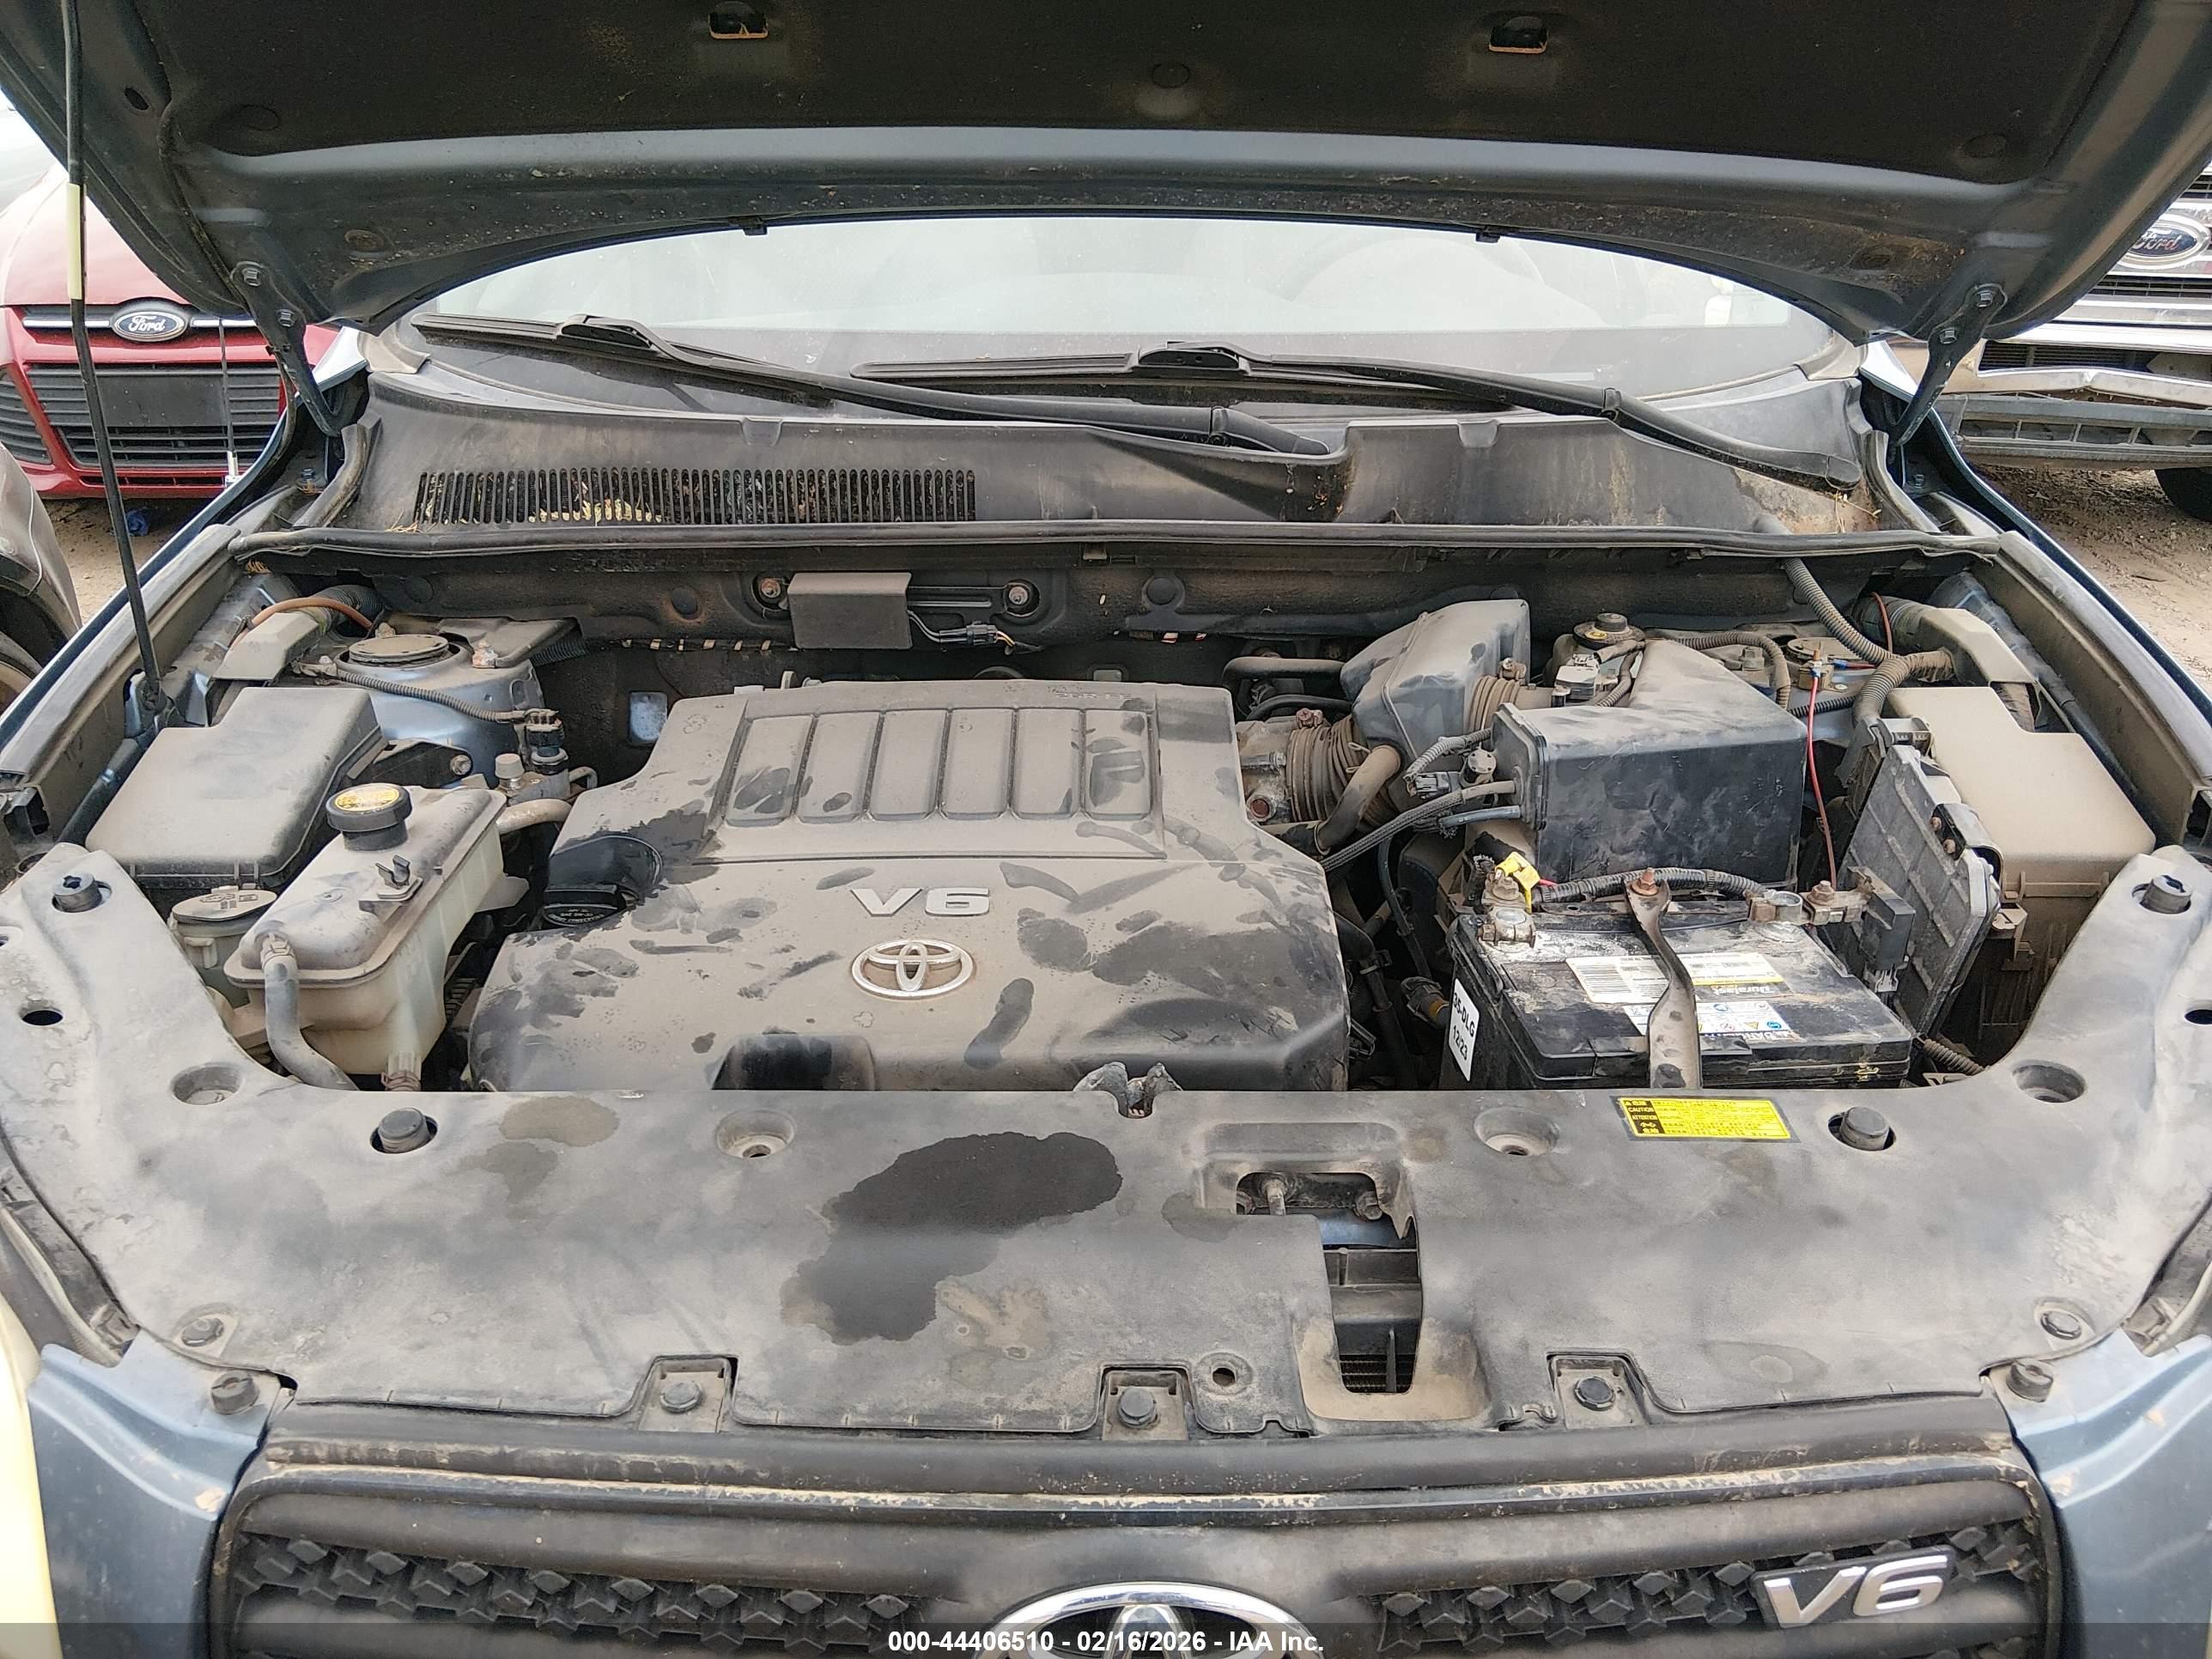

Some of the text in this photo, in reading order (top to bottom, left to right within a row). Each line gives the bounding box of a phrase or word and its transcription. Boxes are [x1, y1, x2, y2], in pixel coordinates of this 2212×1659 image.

[2132, 228, 2183, 251] Ford
[128, 314, 167, 332] Ford
[850, 887, 990, 917] V6
[1711, 985, 1778, 996] Duralast
[1453, 992, 1475, 1038] 35-DLG
[1763, 1554, 1949, 1629] V6
